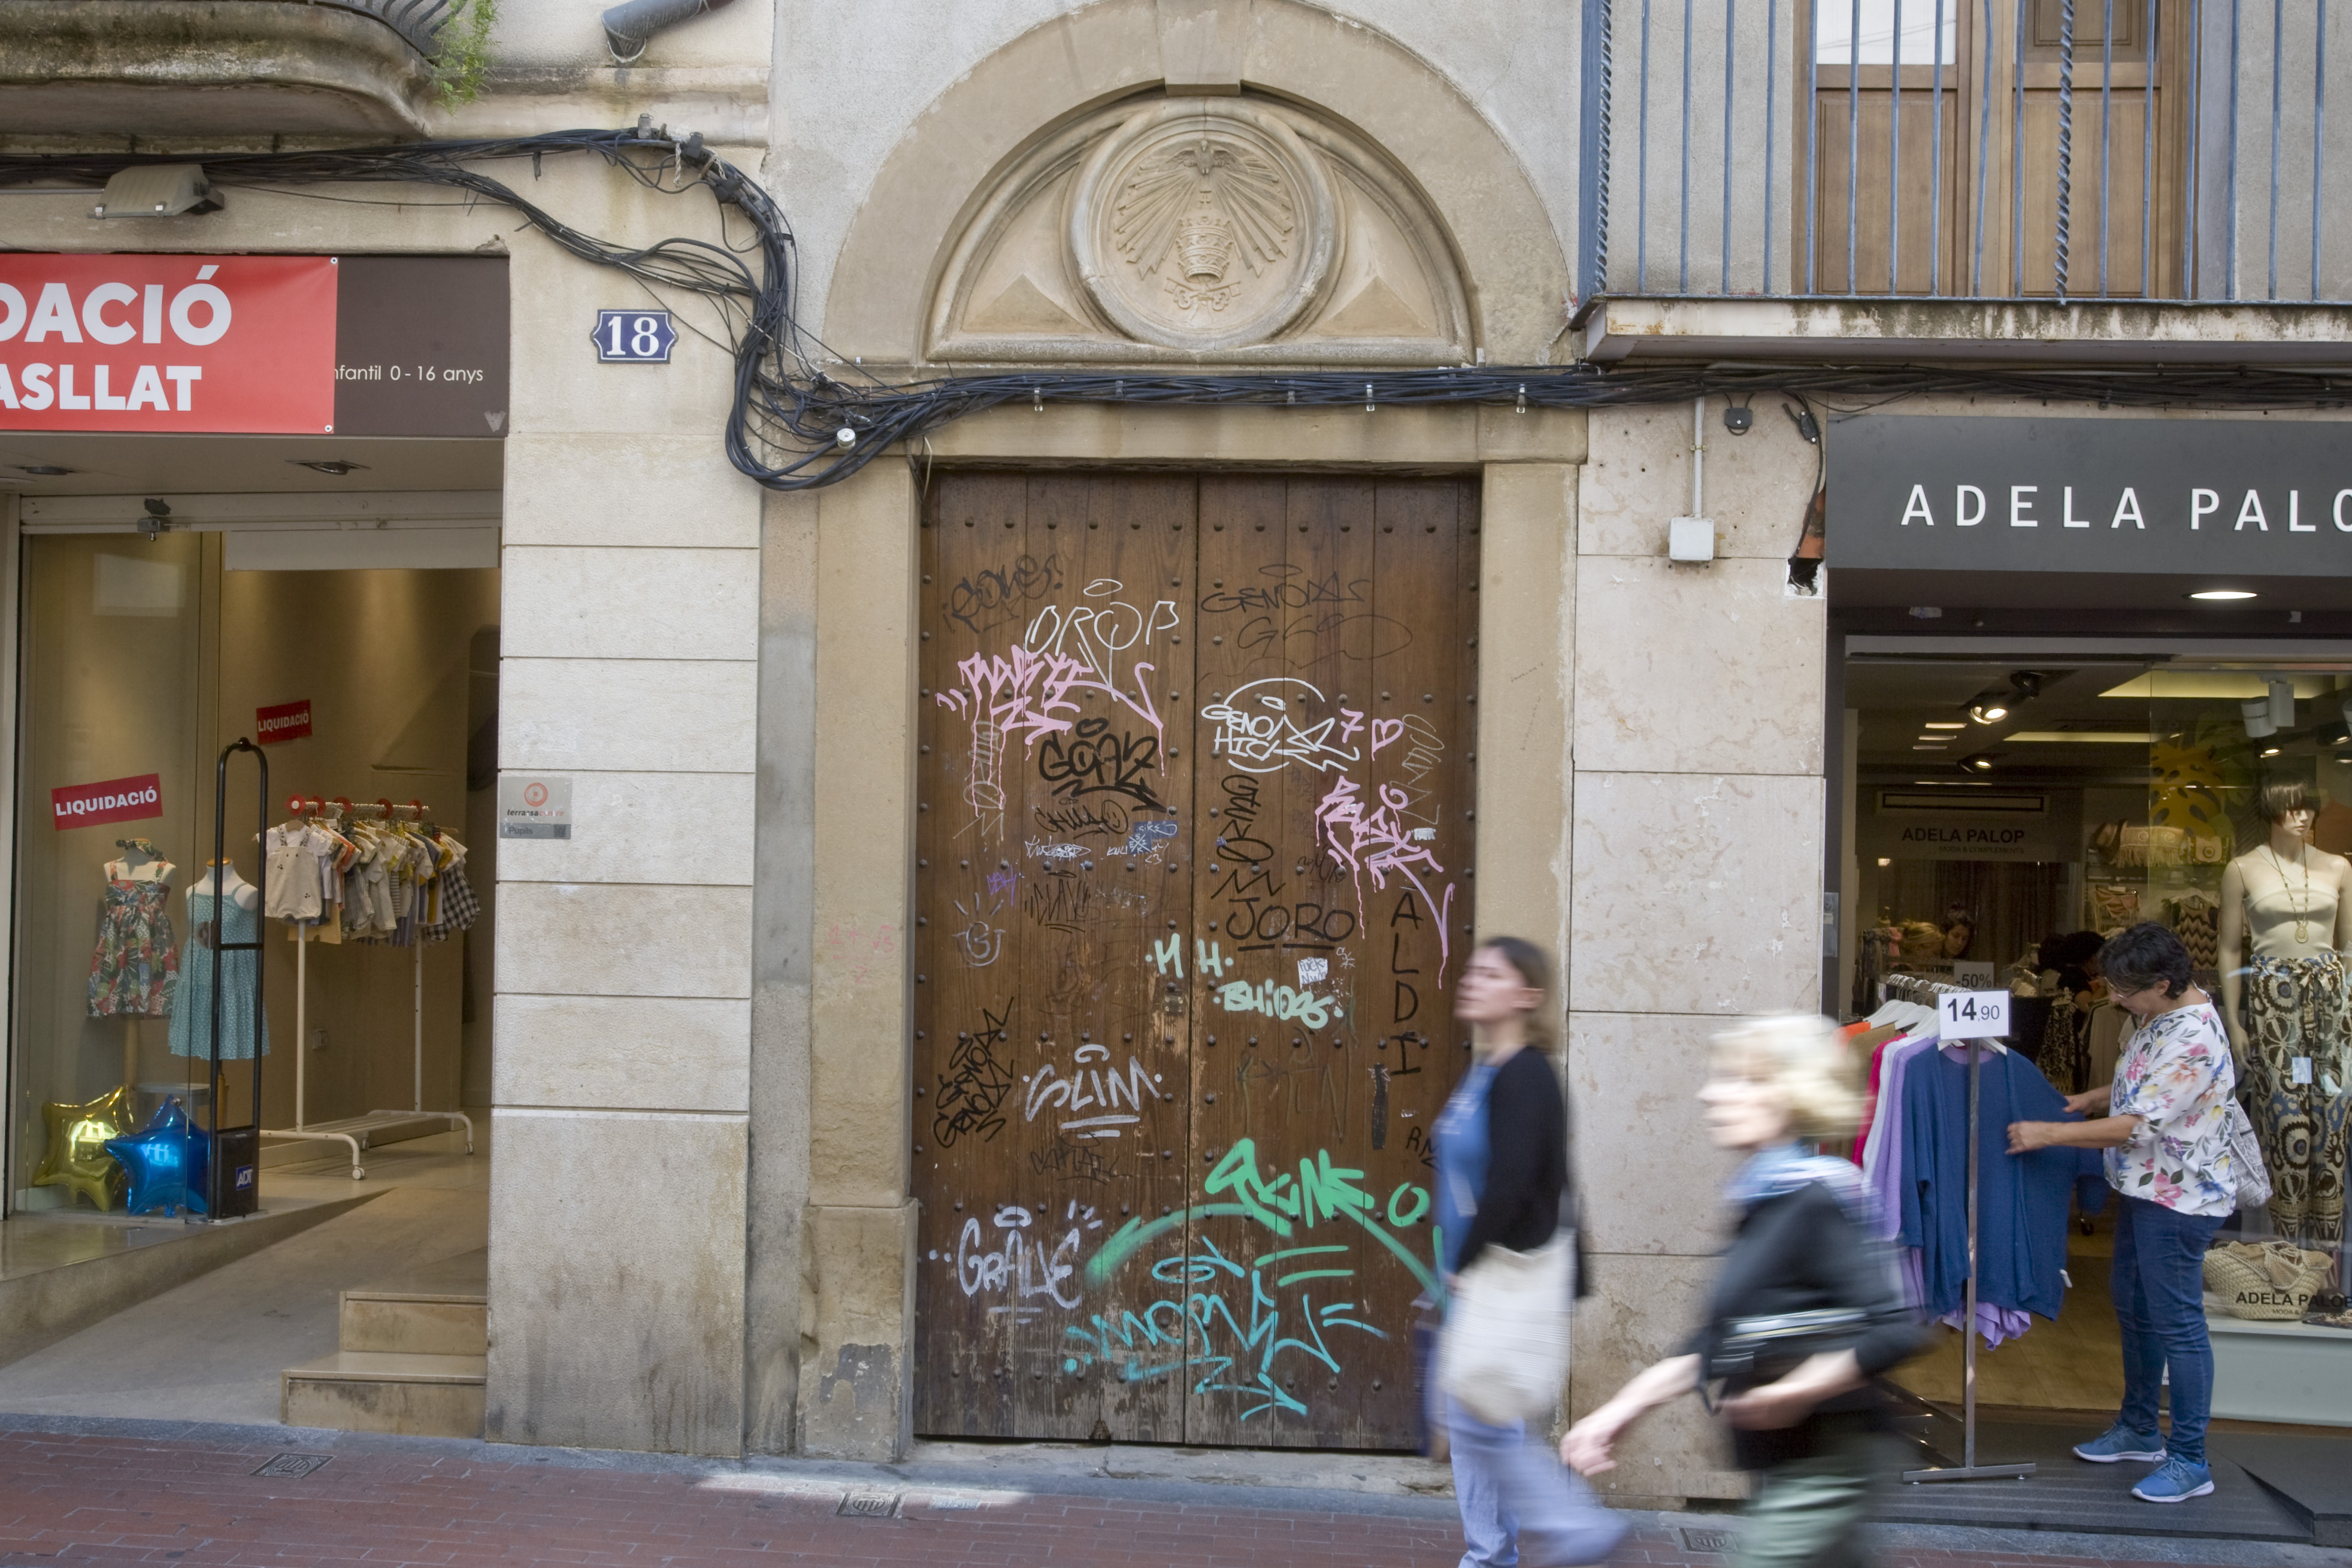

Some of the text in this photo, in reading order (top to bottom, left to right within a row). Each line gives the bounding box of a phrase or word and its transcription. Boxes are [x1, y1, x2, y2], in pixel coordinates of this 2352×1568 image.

[607, 316, 659, 356] 18
[418, 366, 435, 381] 16
[443, 369, 483, 384] anys
[1901, 484, 2145, 529] ADELA
[258, 709, 309, 732] LIQUIDACIÓ
[55, 786, 158, 816] LIQUIDACIÓ
[508, 827, 533, 836] Pupils
[1902, 828, 2025, 843] ADELA PALOP
[1226, 897, 1355, 942] JORO
[1956, 974, 1991, 988] -50%
[237, 1169, 253, 1186] ADT
[2236, 1292, 2293, 1306] ADELA
